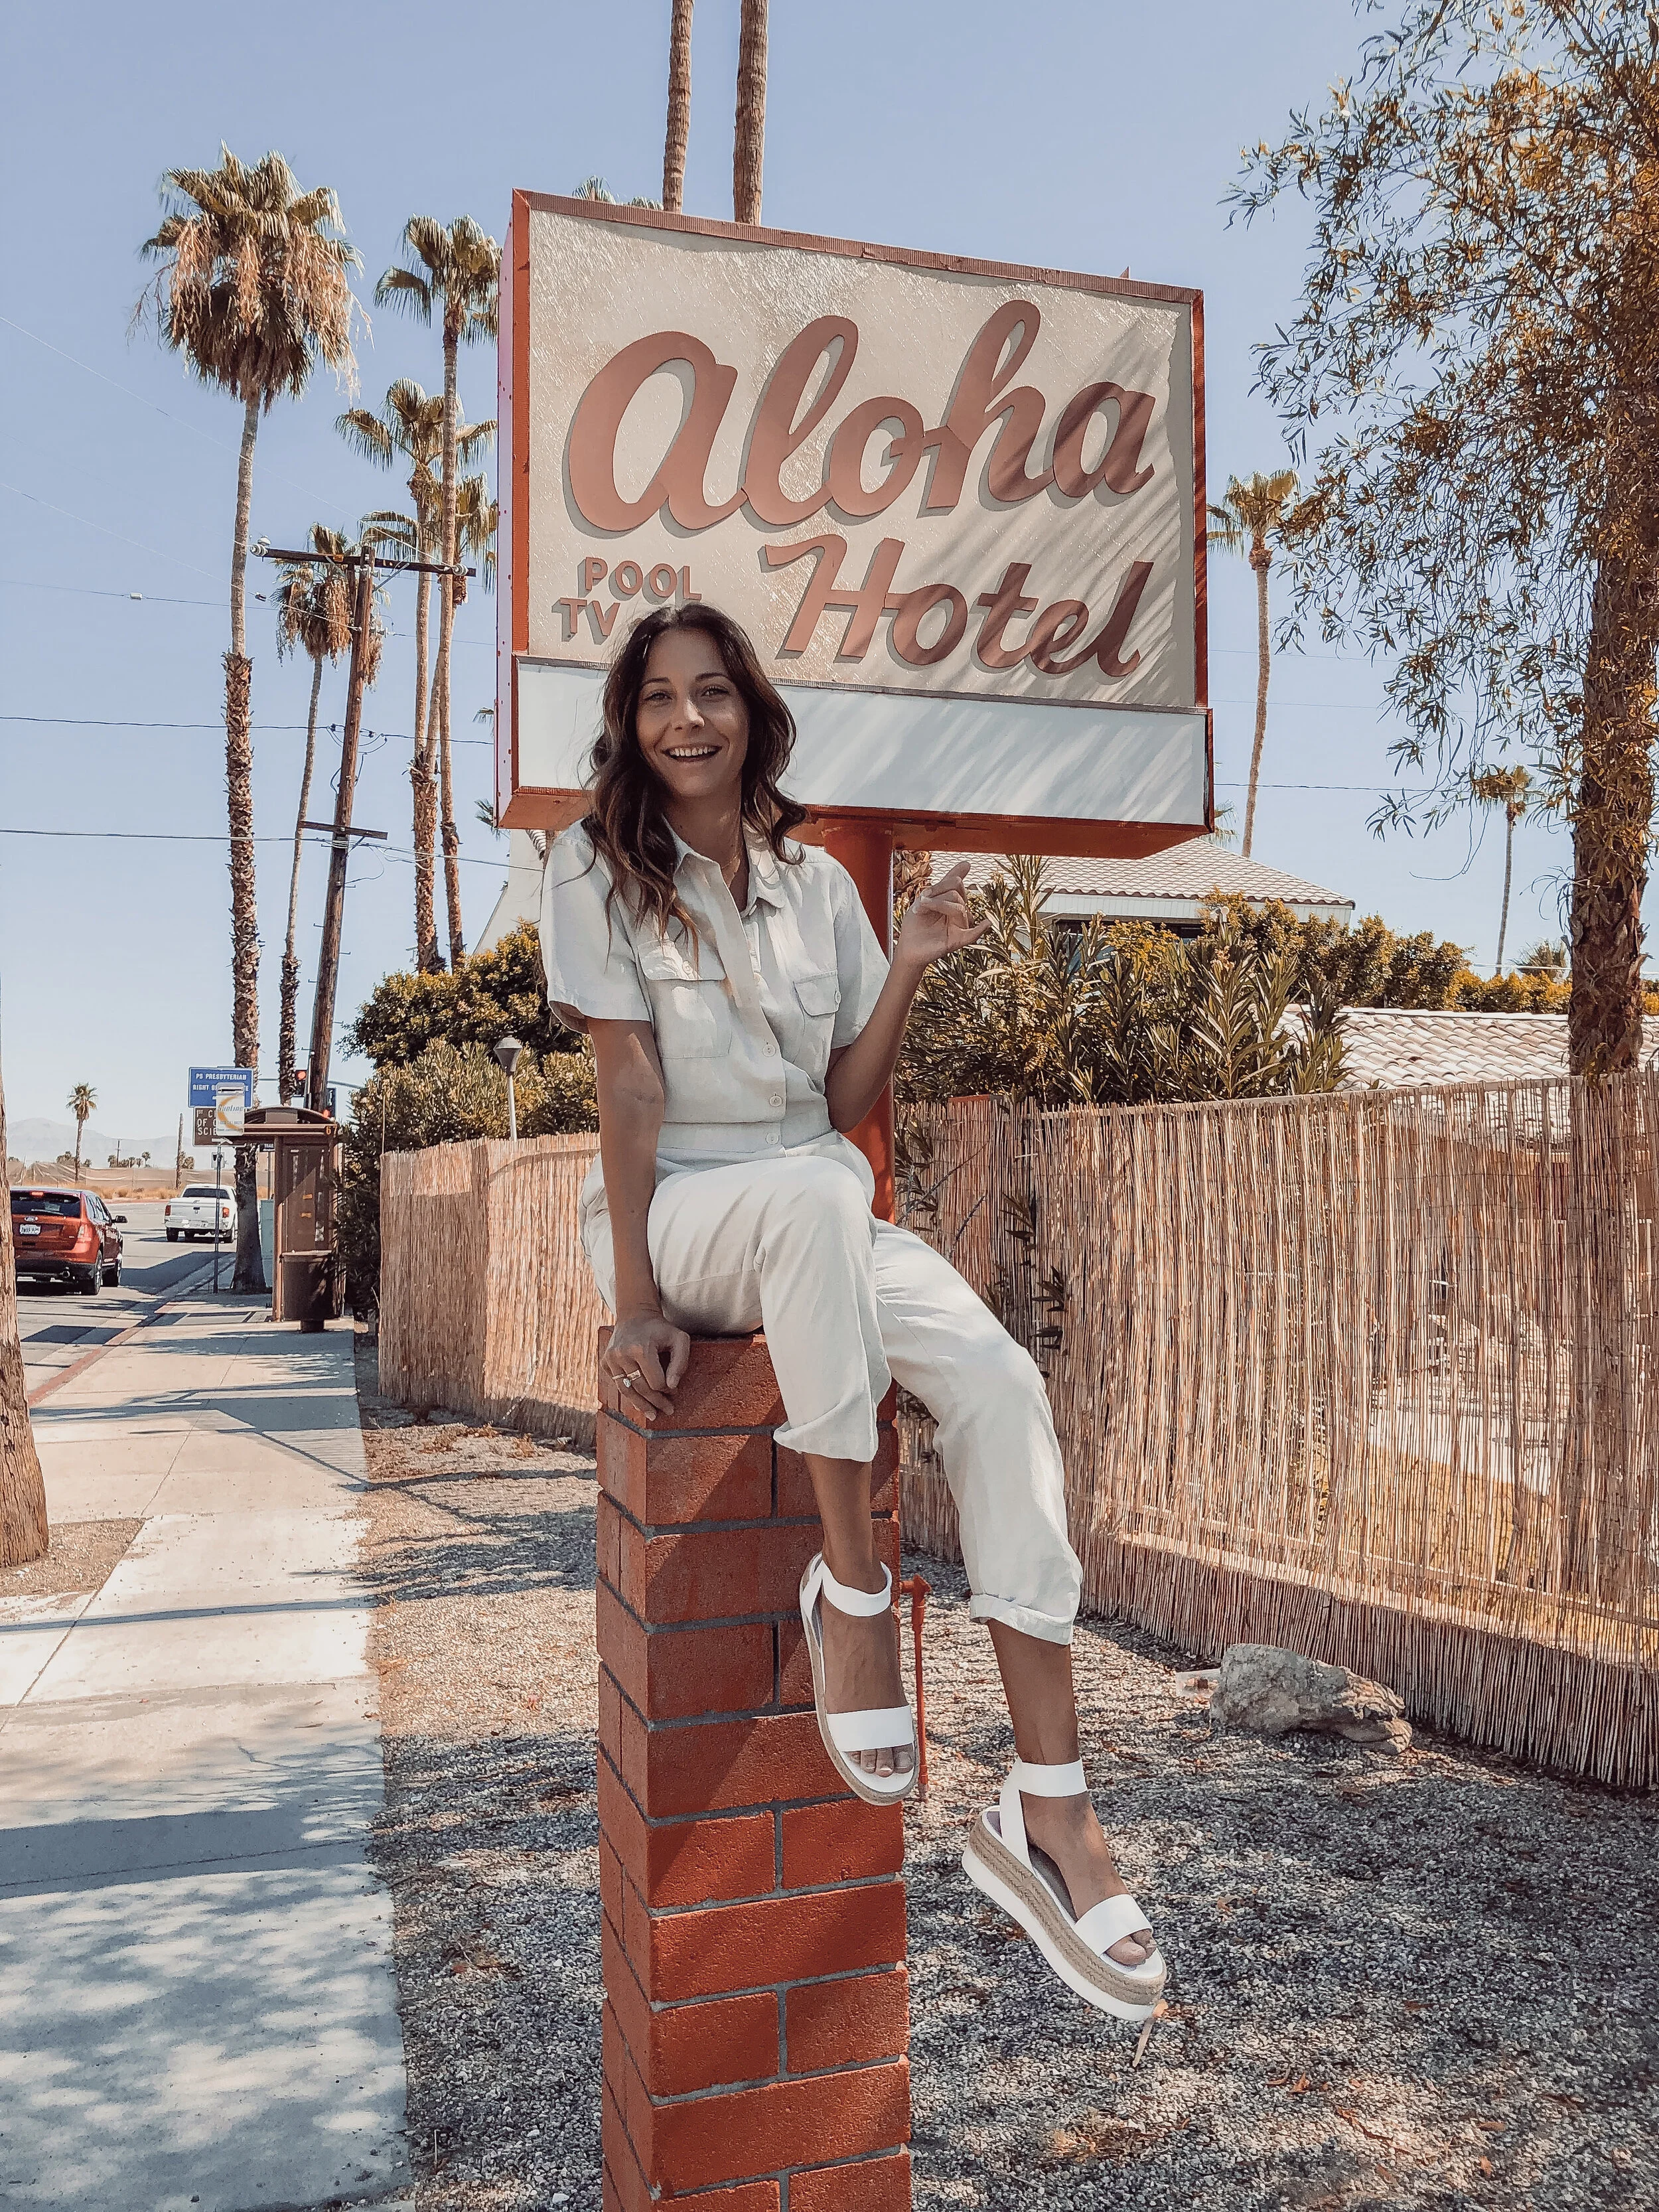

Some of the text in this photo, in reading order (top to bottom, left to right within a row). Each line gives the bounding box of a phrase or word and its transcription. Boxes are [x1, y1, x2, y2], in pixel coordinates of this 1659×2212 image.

[581, 557, 701, 601] POOL
[556, 597, 620, 640] TV
[763, 534, 1153, 678] Hotel
[197, 1118, 208, 1128] OF
